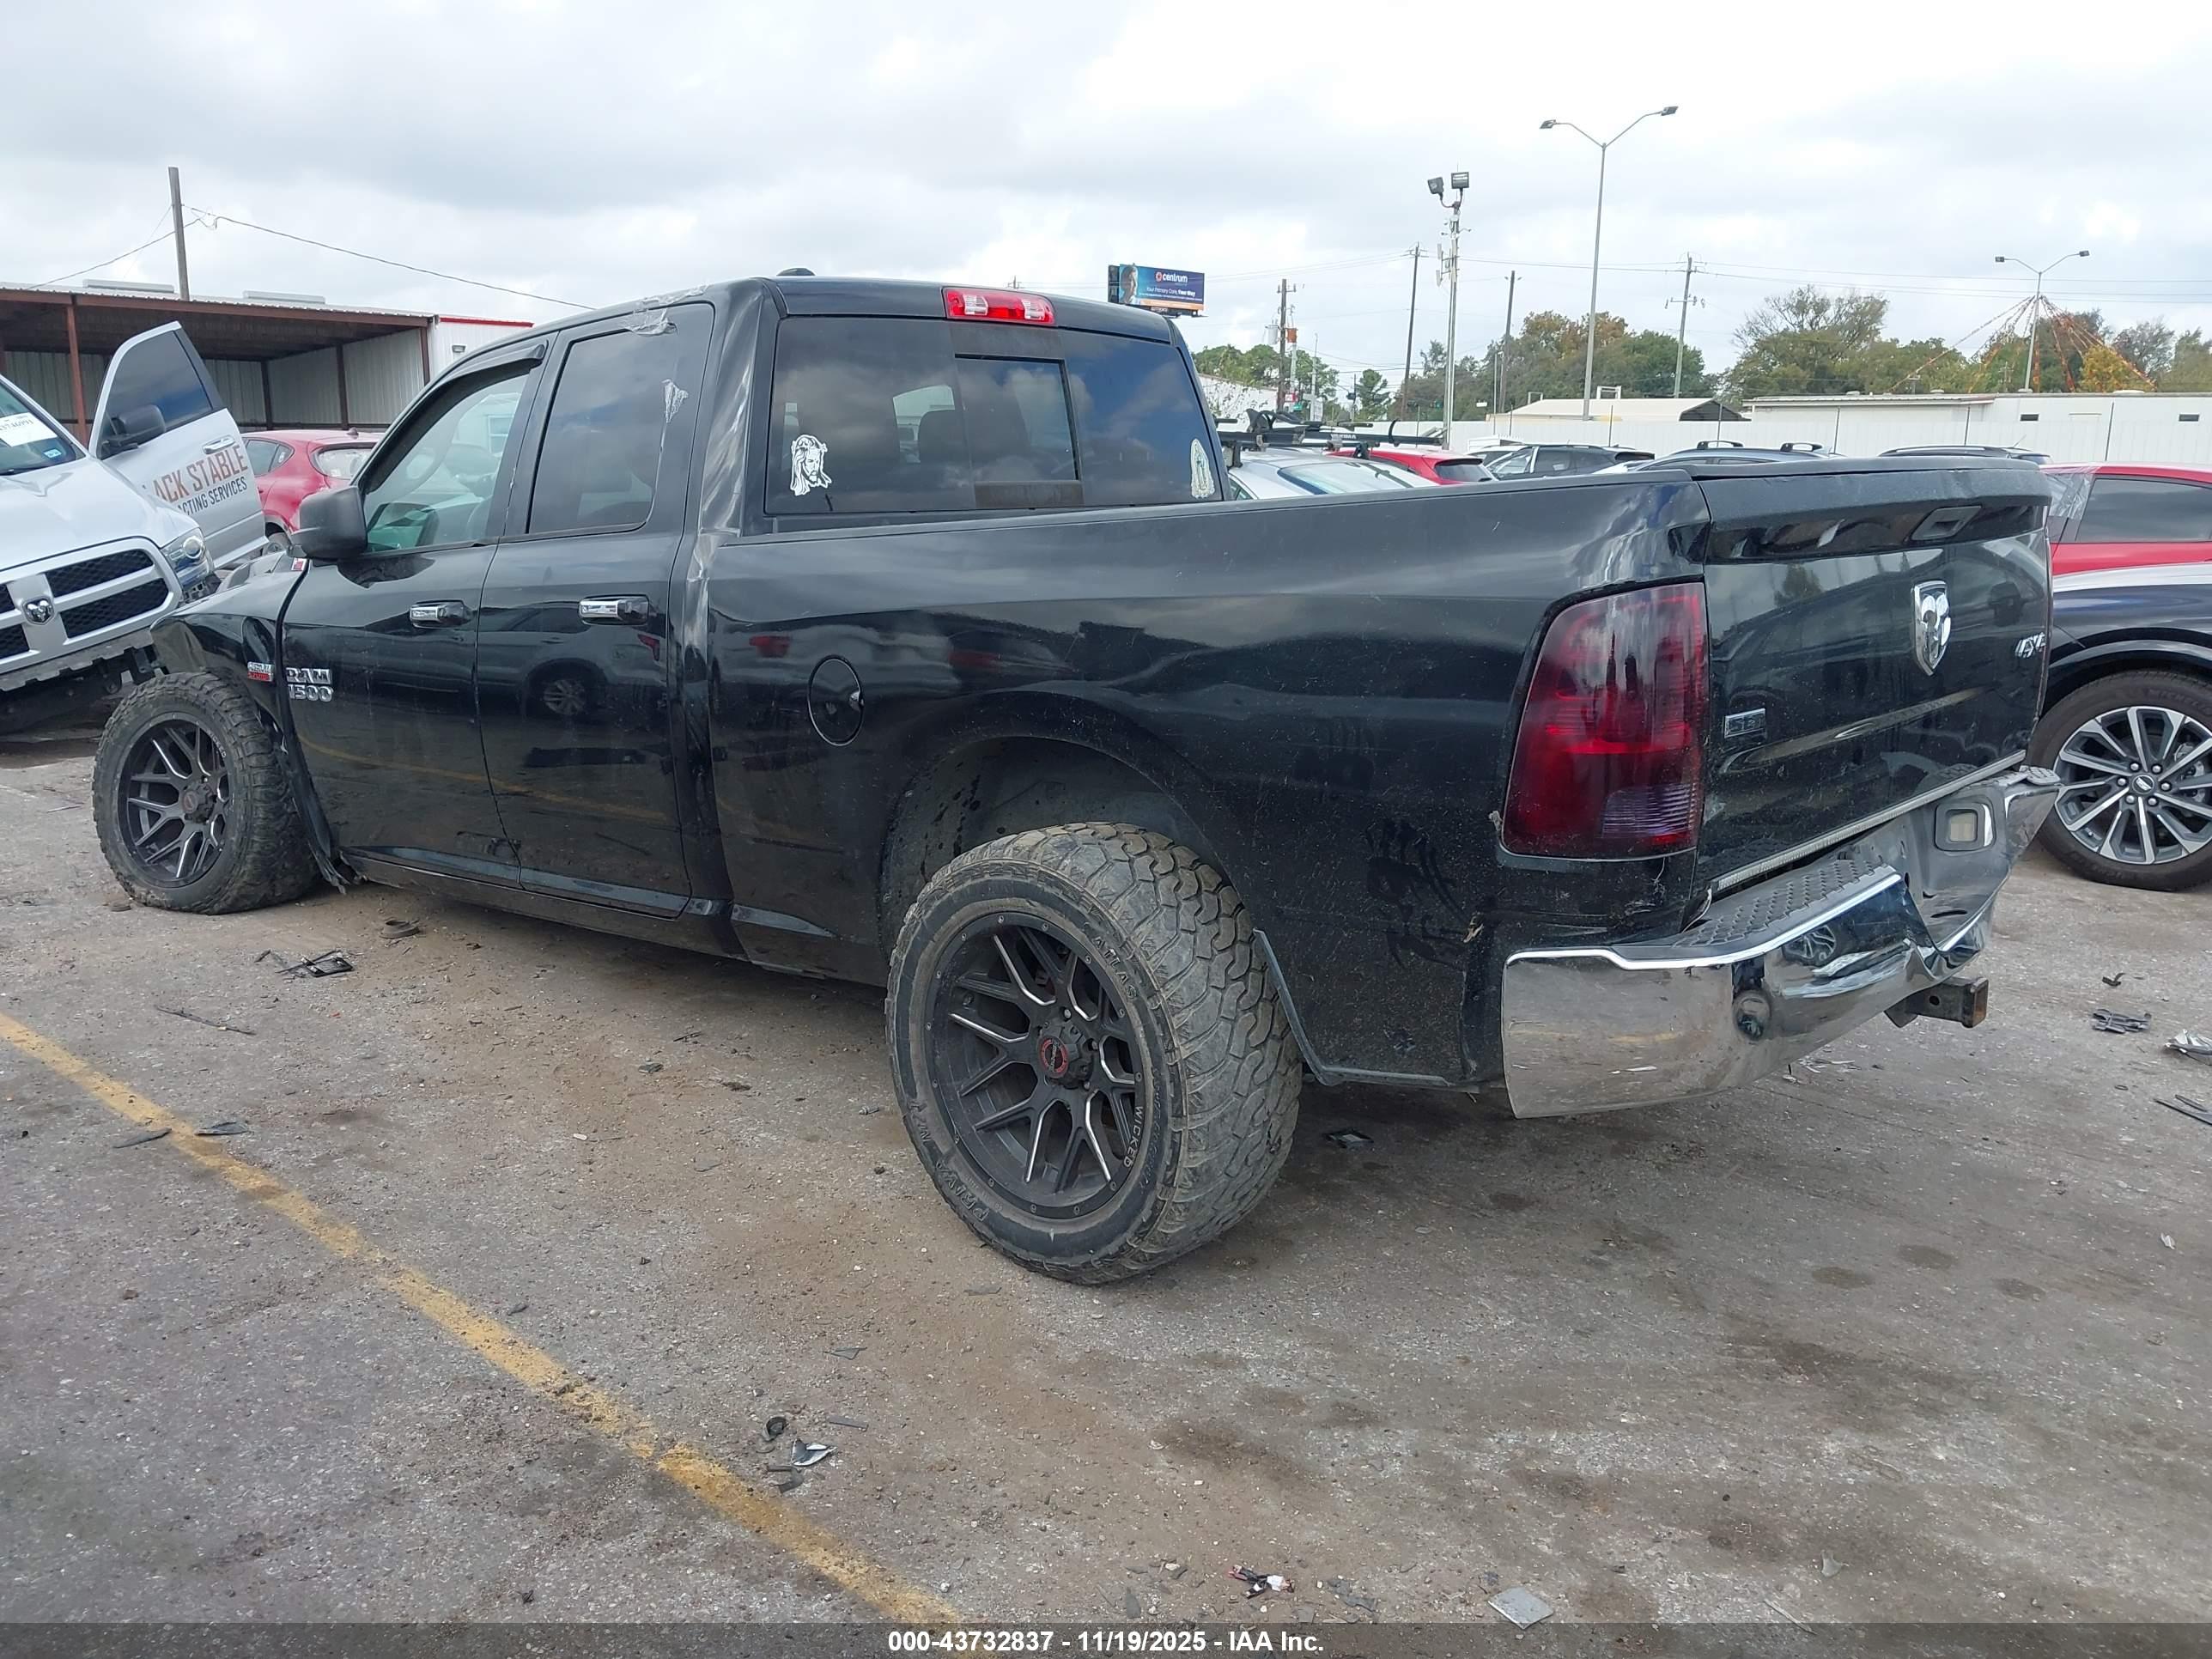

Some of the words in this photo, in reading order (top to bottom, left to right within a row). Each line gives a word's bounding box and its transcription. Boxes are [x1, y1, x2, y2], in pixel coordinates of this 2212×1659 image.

[1162, 273, 1188, 283] centrum
[153, 469, 190, 503] ACK
[186, 446, 248, 492] STABLE
[208, 476, 248, 505] SERVICES
[286, 667, 331, 684] RAM
[288, 684, 334, 702] 1500
[1092, 936, 1138, 1000] ATLAS
[1123, 1105, 1145, 1169] WICKED
